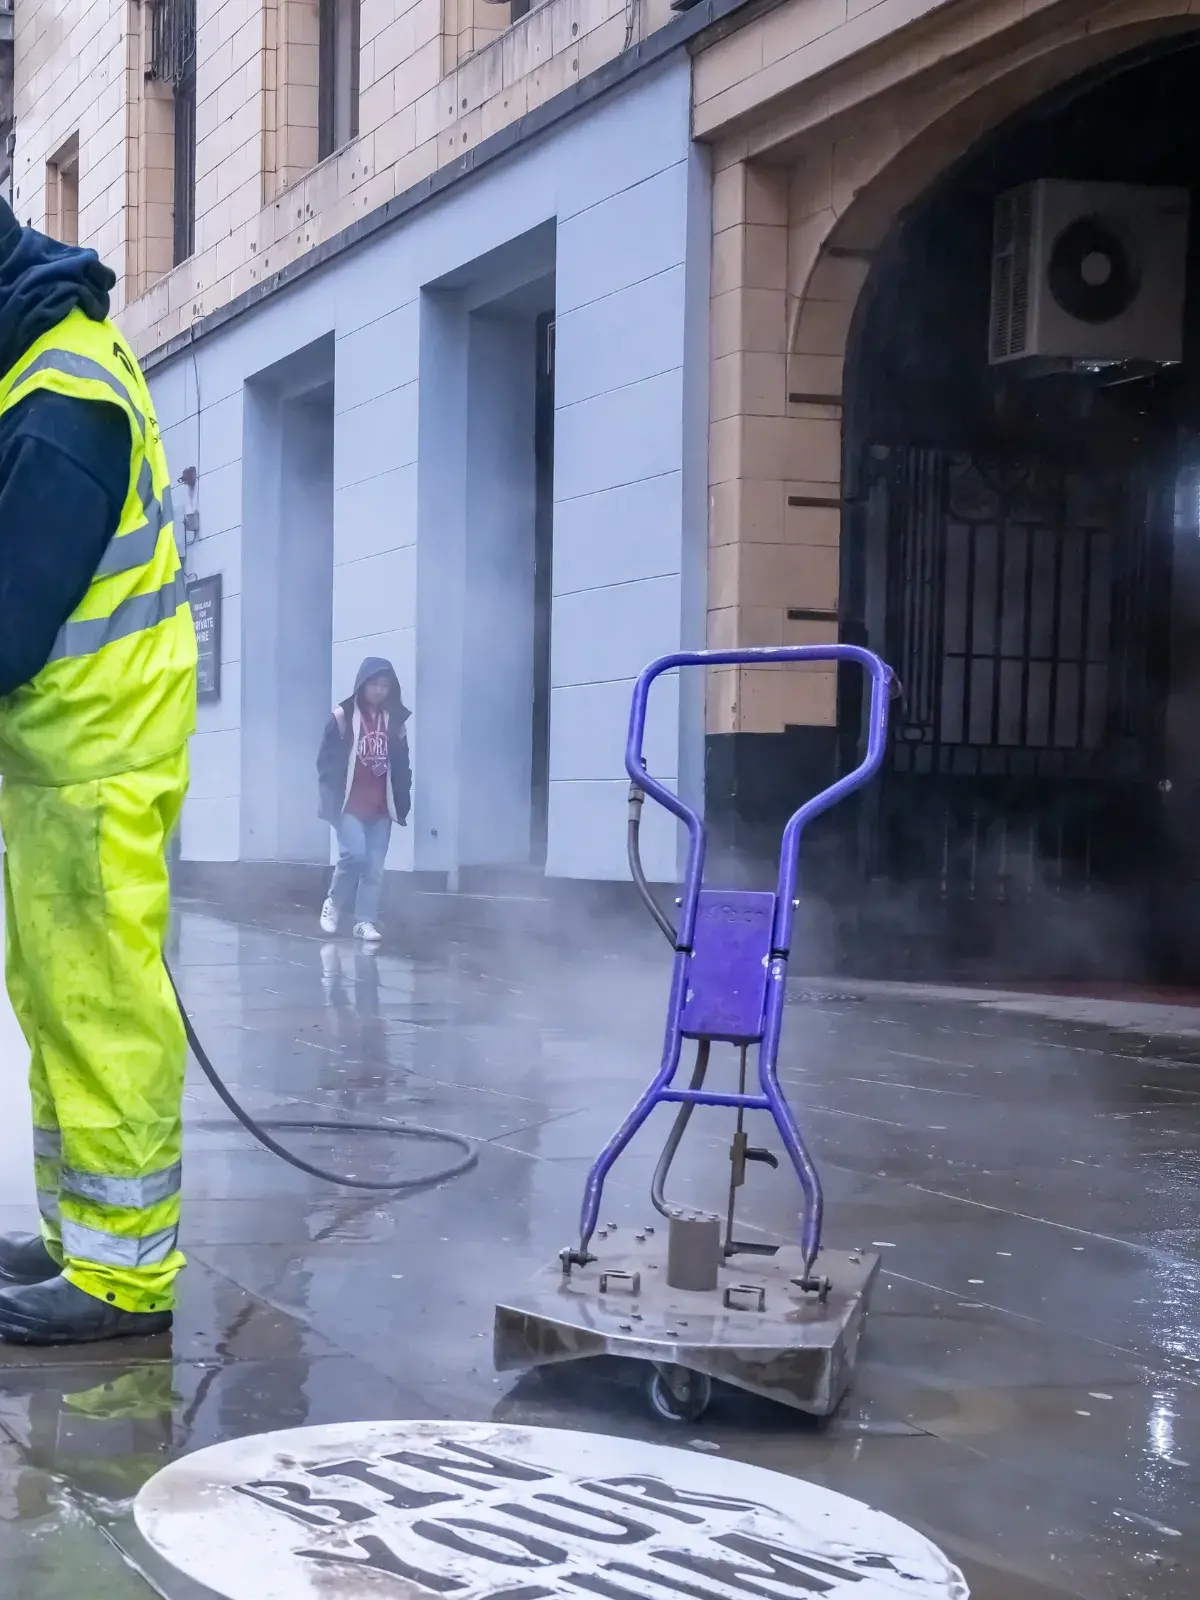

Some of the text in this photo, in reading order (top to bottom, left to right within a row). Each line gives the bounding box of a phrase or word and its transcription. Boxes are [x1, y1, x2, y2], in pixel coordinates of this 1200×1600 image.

[195, 617, 213, 630] RIVATE
[231, 1439, 555, 1526] BIN
[293, 1477, 756, 1592] YOUR
